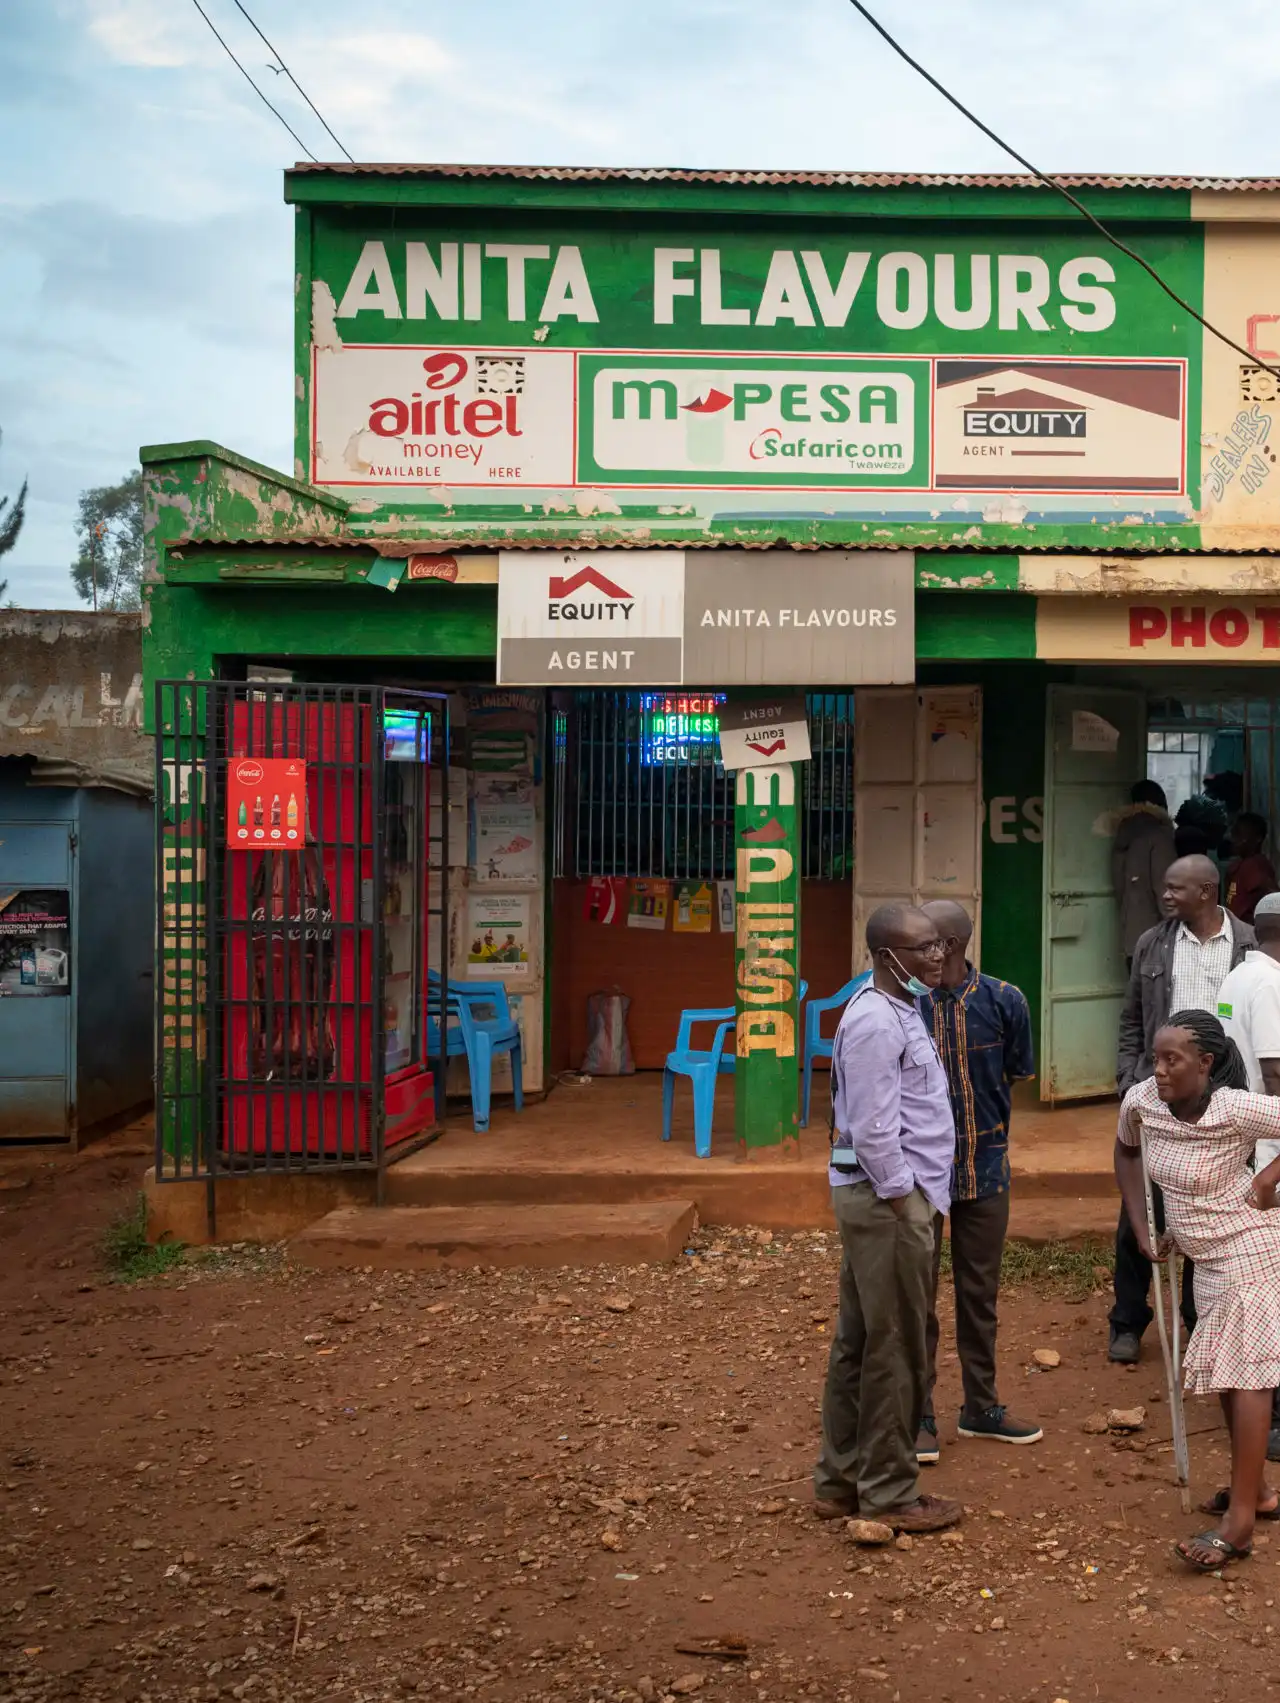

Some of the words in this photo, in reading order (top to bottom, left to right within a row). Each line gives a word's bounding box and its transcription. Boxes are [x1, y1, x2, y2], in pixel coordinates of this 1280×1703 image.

[336, 240, 600, 323] ANITA
[654, 247, 1116, 333] FLAVOURS
[369, 393, 523, 438] airtel
[966, 412, 1083, 435] EQUITY
[403, 443, 483, 466] money
[764, 438, 902, 459] Safaricom
[963, 445, 1005, 456] AGENT
[1204, 403, 1272, 503] DEALERS
[369, 466, 441, 477] AVAILABLE
[489, 467, 522, 478] HERE
[849, 460, 906, 470] Twaweza
[1240, 454, 1271, 494] IN
[547, 603, 636, 621] EQUITY
[700, 609, 772, 628] ANITA
[778, 609, 898, 629] FLAVOURS
[547, 650, 636, 671] AGENT
[743, 706, 783, 721] AGENT
[744, 729, 785, 743] EQUITY
